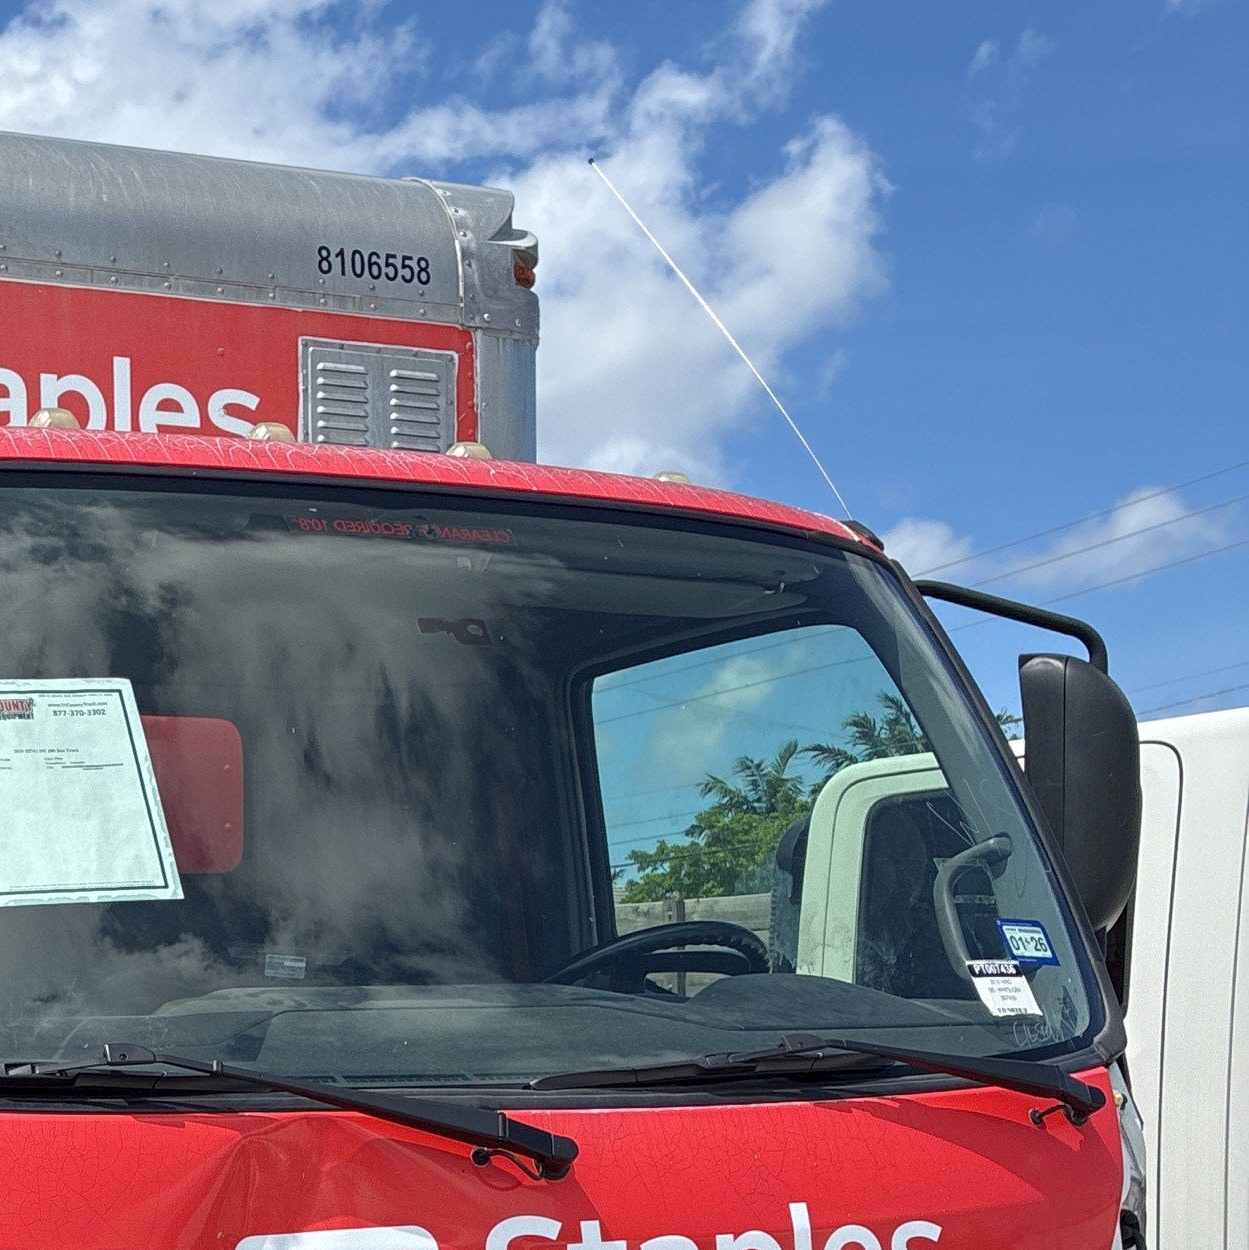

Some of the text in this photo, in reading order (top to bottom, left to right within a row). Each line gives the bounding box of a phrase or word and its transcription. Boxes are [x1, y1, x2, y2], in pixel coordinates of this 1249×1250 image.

[317, 245, 431, 286] 8106558
[52, 708, 107, 717] 877-370-3302
[1010, 934, 1049, 953] 01 26
